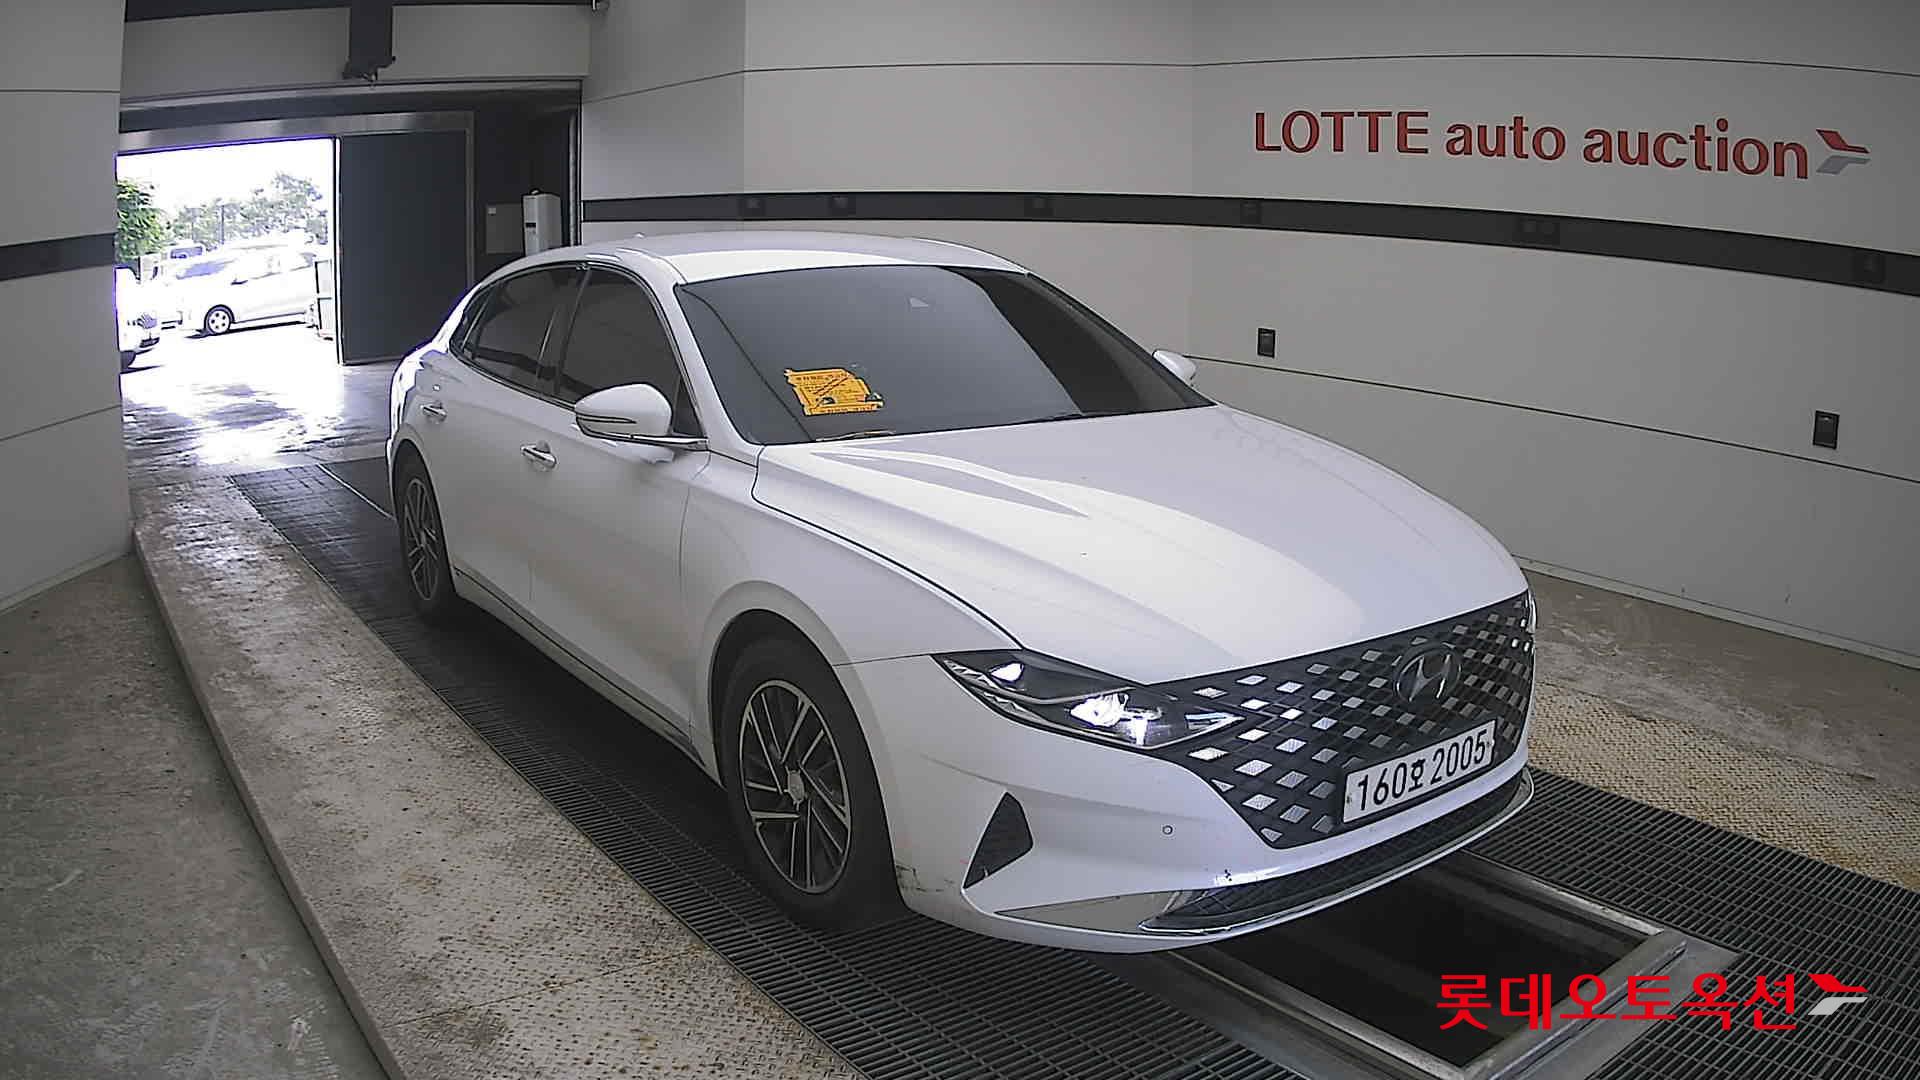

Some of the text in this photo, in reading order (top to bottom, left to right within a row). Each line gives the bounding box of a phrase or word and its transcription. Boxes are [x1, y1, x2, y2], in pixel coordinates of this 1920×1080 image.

[1254, 110, 1809, 180] LOTTE auto auction
[1430, 729, 1488, 785] 2005
